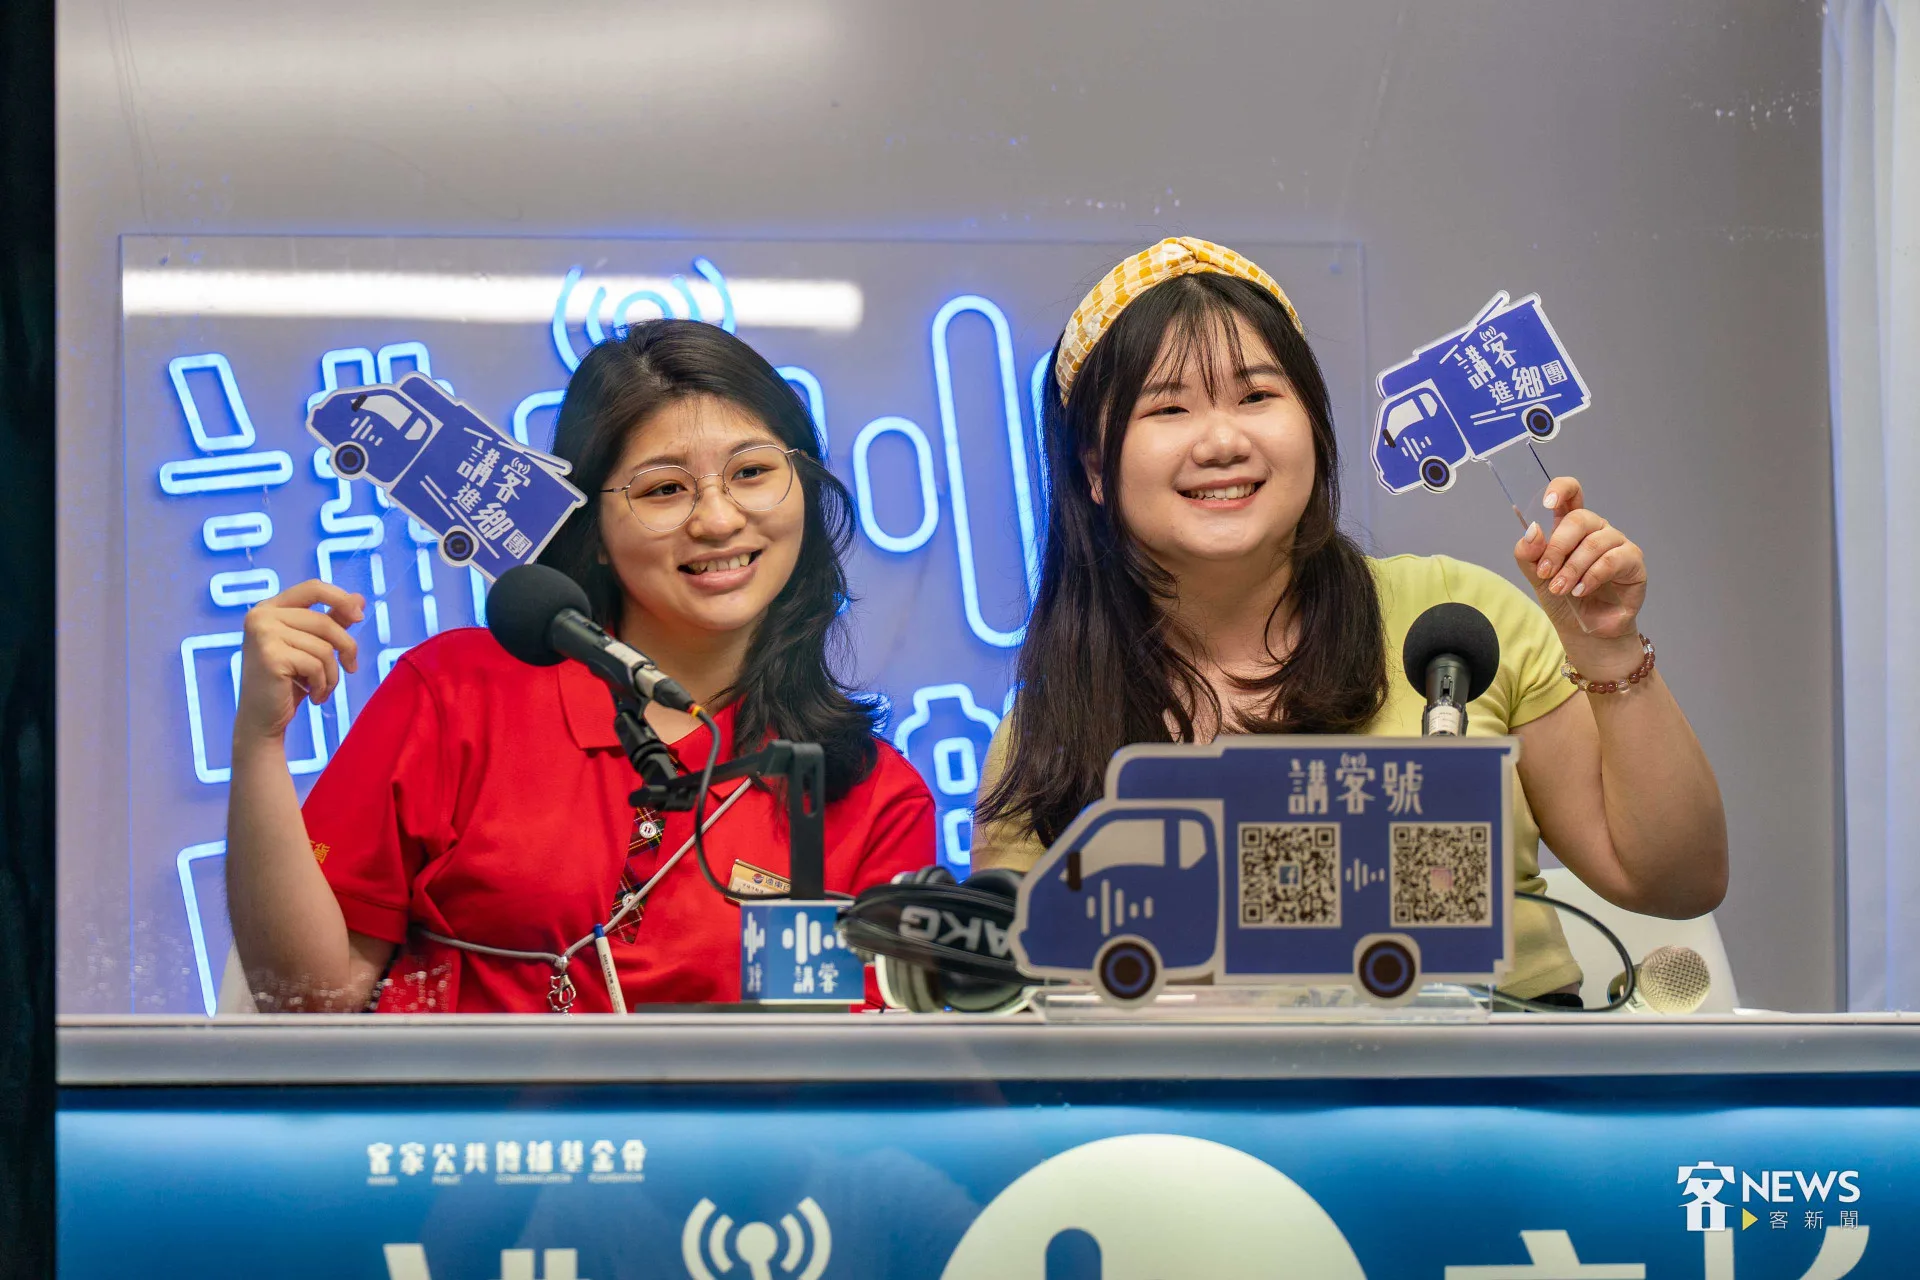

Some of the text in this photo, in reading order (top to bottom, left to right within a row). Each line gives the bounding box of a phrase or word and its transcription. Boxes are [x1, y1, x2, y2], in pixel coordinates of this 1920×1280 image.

[1454, 325, 1517, 391] 講客
[1489, 359, 1568, 406] 進鄉團
[455, 438, 532, 504] 講客
[451, 482, 534, 560] 進鄉團
[1287, 752, 1425, 815] 講客號
[899, 904, 1010, 958] AKG
[793, 962, 839, 994] 講客
